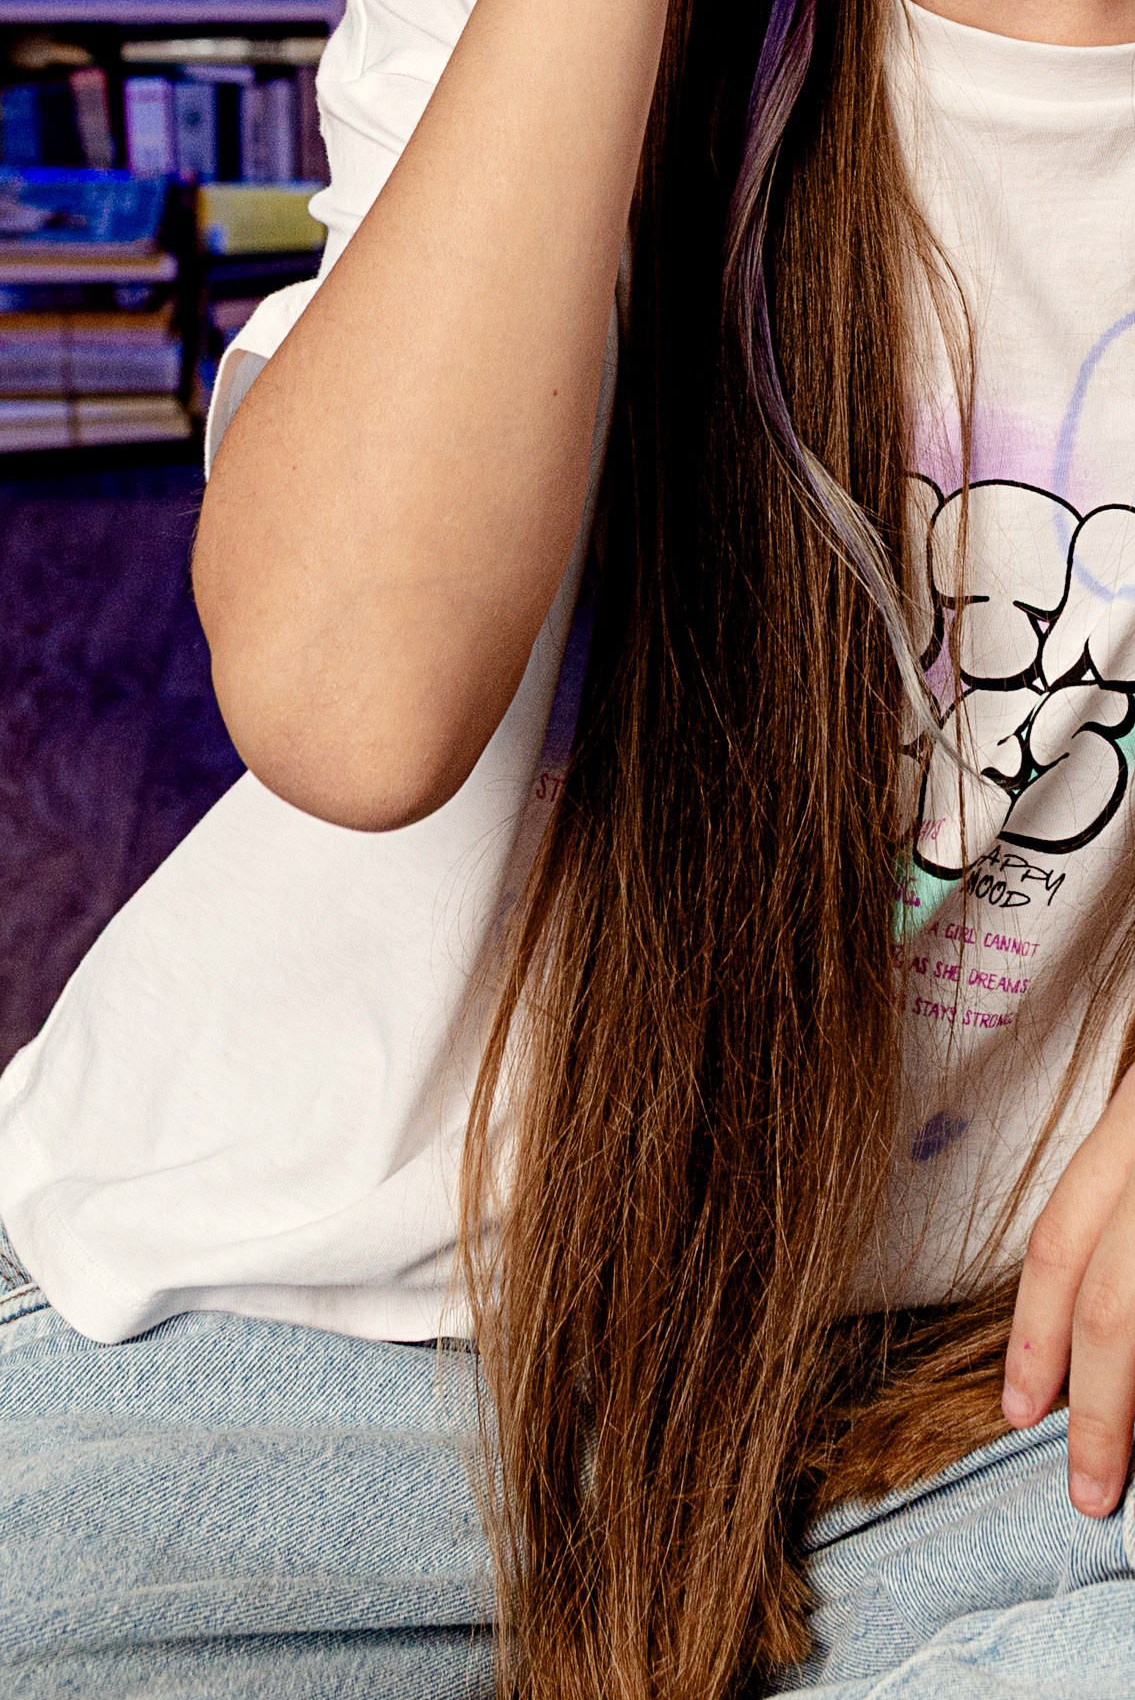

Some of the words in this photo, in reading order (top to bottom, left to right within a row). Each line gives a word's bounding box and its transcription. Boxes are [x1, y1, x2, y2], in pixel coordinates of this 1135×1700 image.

[977, 844, 1066, 907] APPY
[945, 923, 975, 944] GIRL
[983, 932, 1041, 957] CANNOT
[910, 956, 929, 975] AS
[934, 961, 962, 982] SHE
[968, 968, 1029, 994] DREAMS
[912, 997, 957, 1024] STAYS
